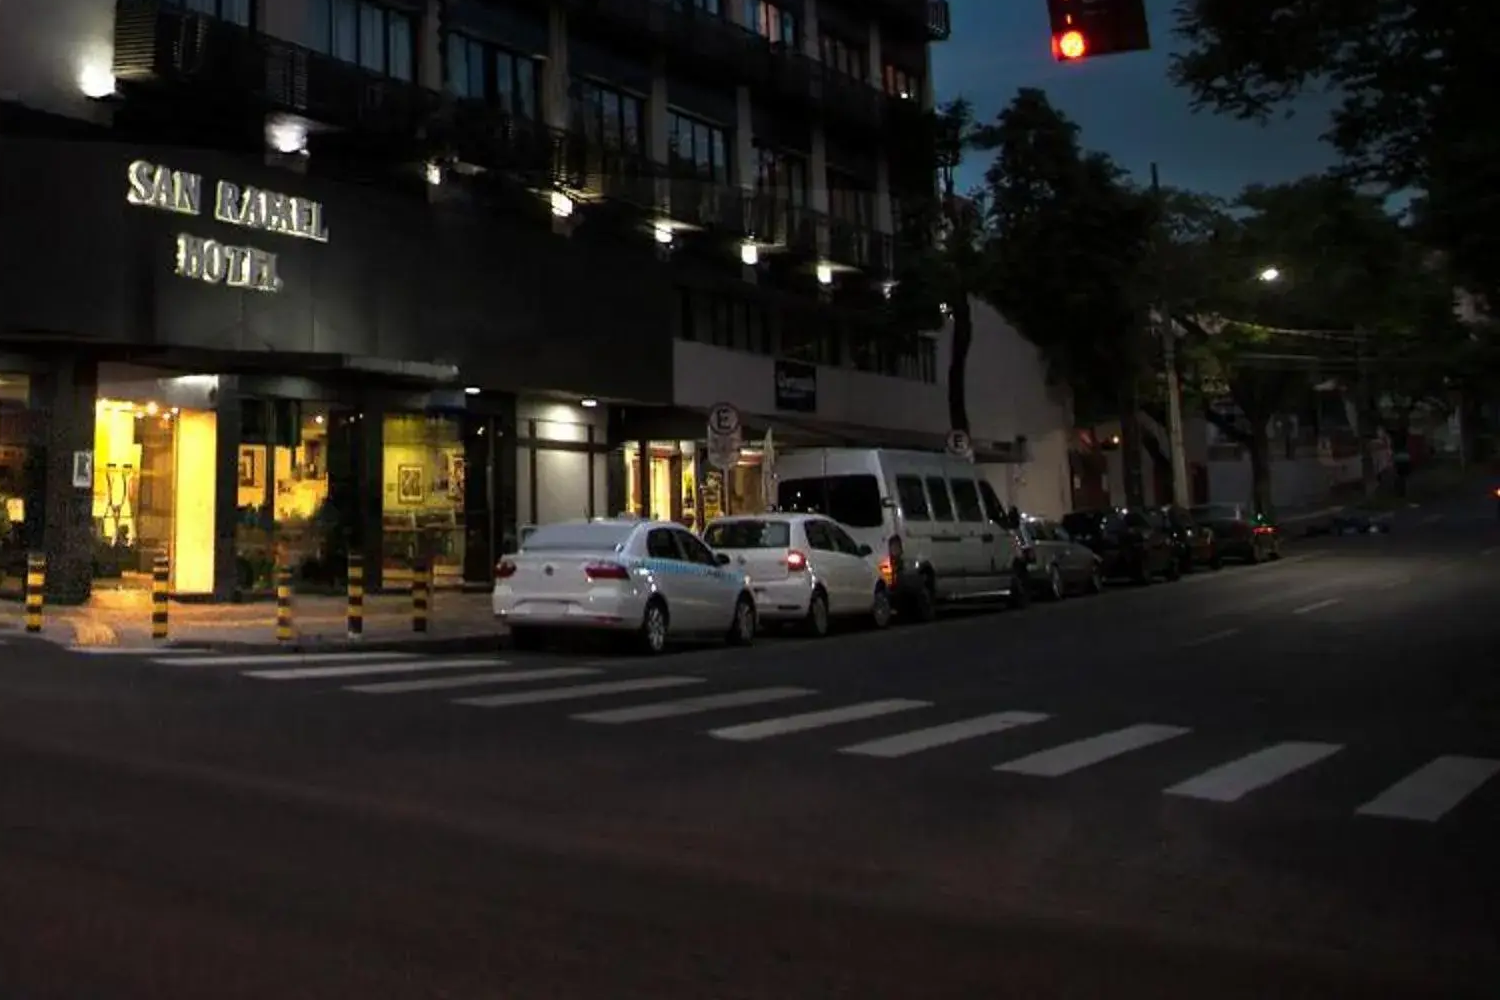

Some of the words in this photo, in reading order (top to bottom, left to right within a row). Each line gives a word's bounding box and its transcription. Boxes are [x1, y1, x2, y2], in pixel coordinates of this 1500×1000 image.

[125, 158, 204, 216] SAN
[213, 178, 330, 243] RAFAEL
[174, 232, 284, 293] HOTEL
[717, 408, 732, 430] E
